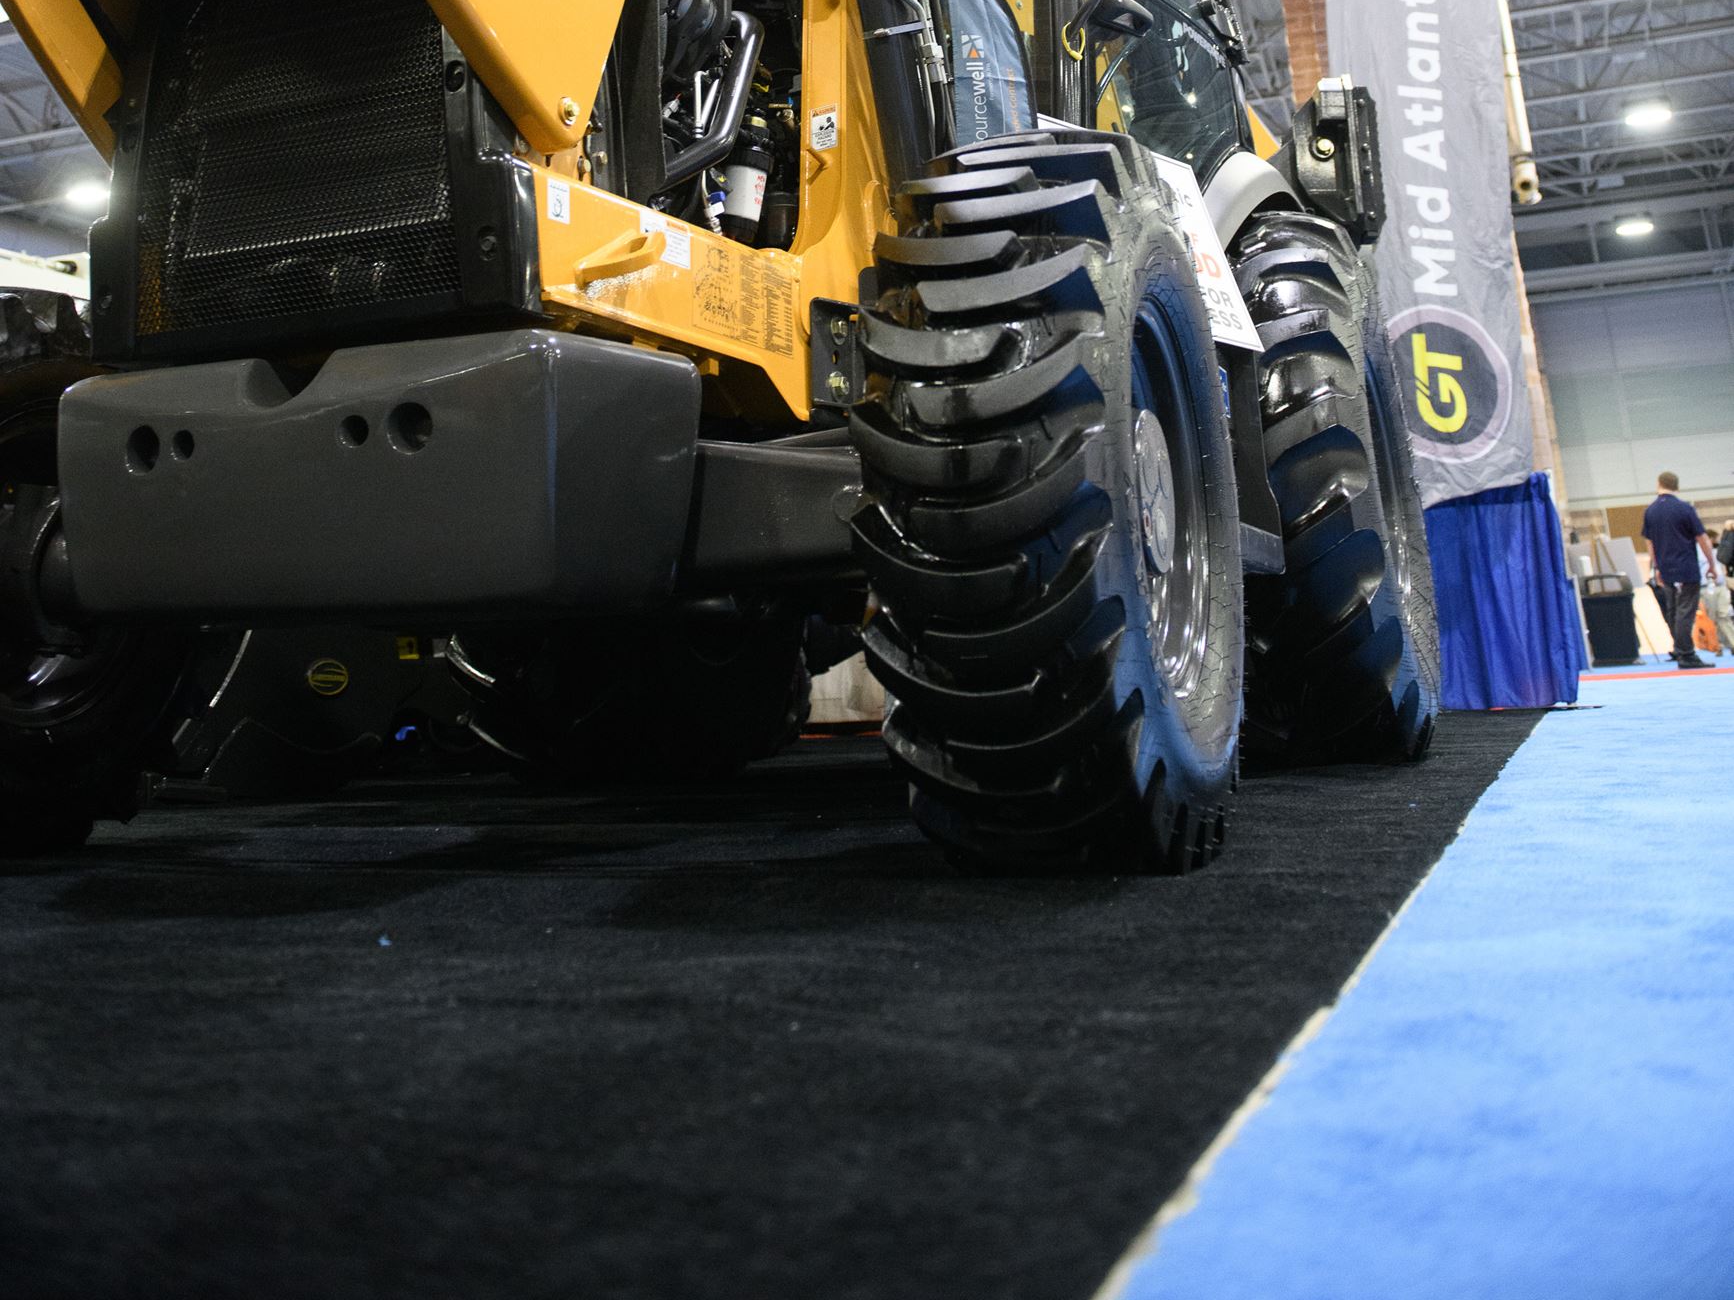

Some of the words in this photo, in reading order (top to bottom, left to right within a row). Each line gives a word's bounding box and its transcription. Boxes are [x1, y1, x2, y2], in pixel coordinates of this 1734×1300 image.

[965, 61, 988, 145] ourcewell
[1405, 183, 1458, 298] Mid
[1411, 333, 1468, 434] GT
